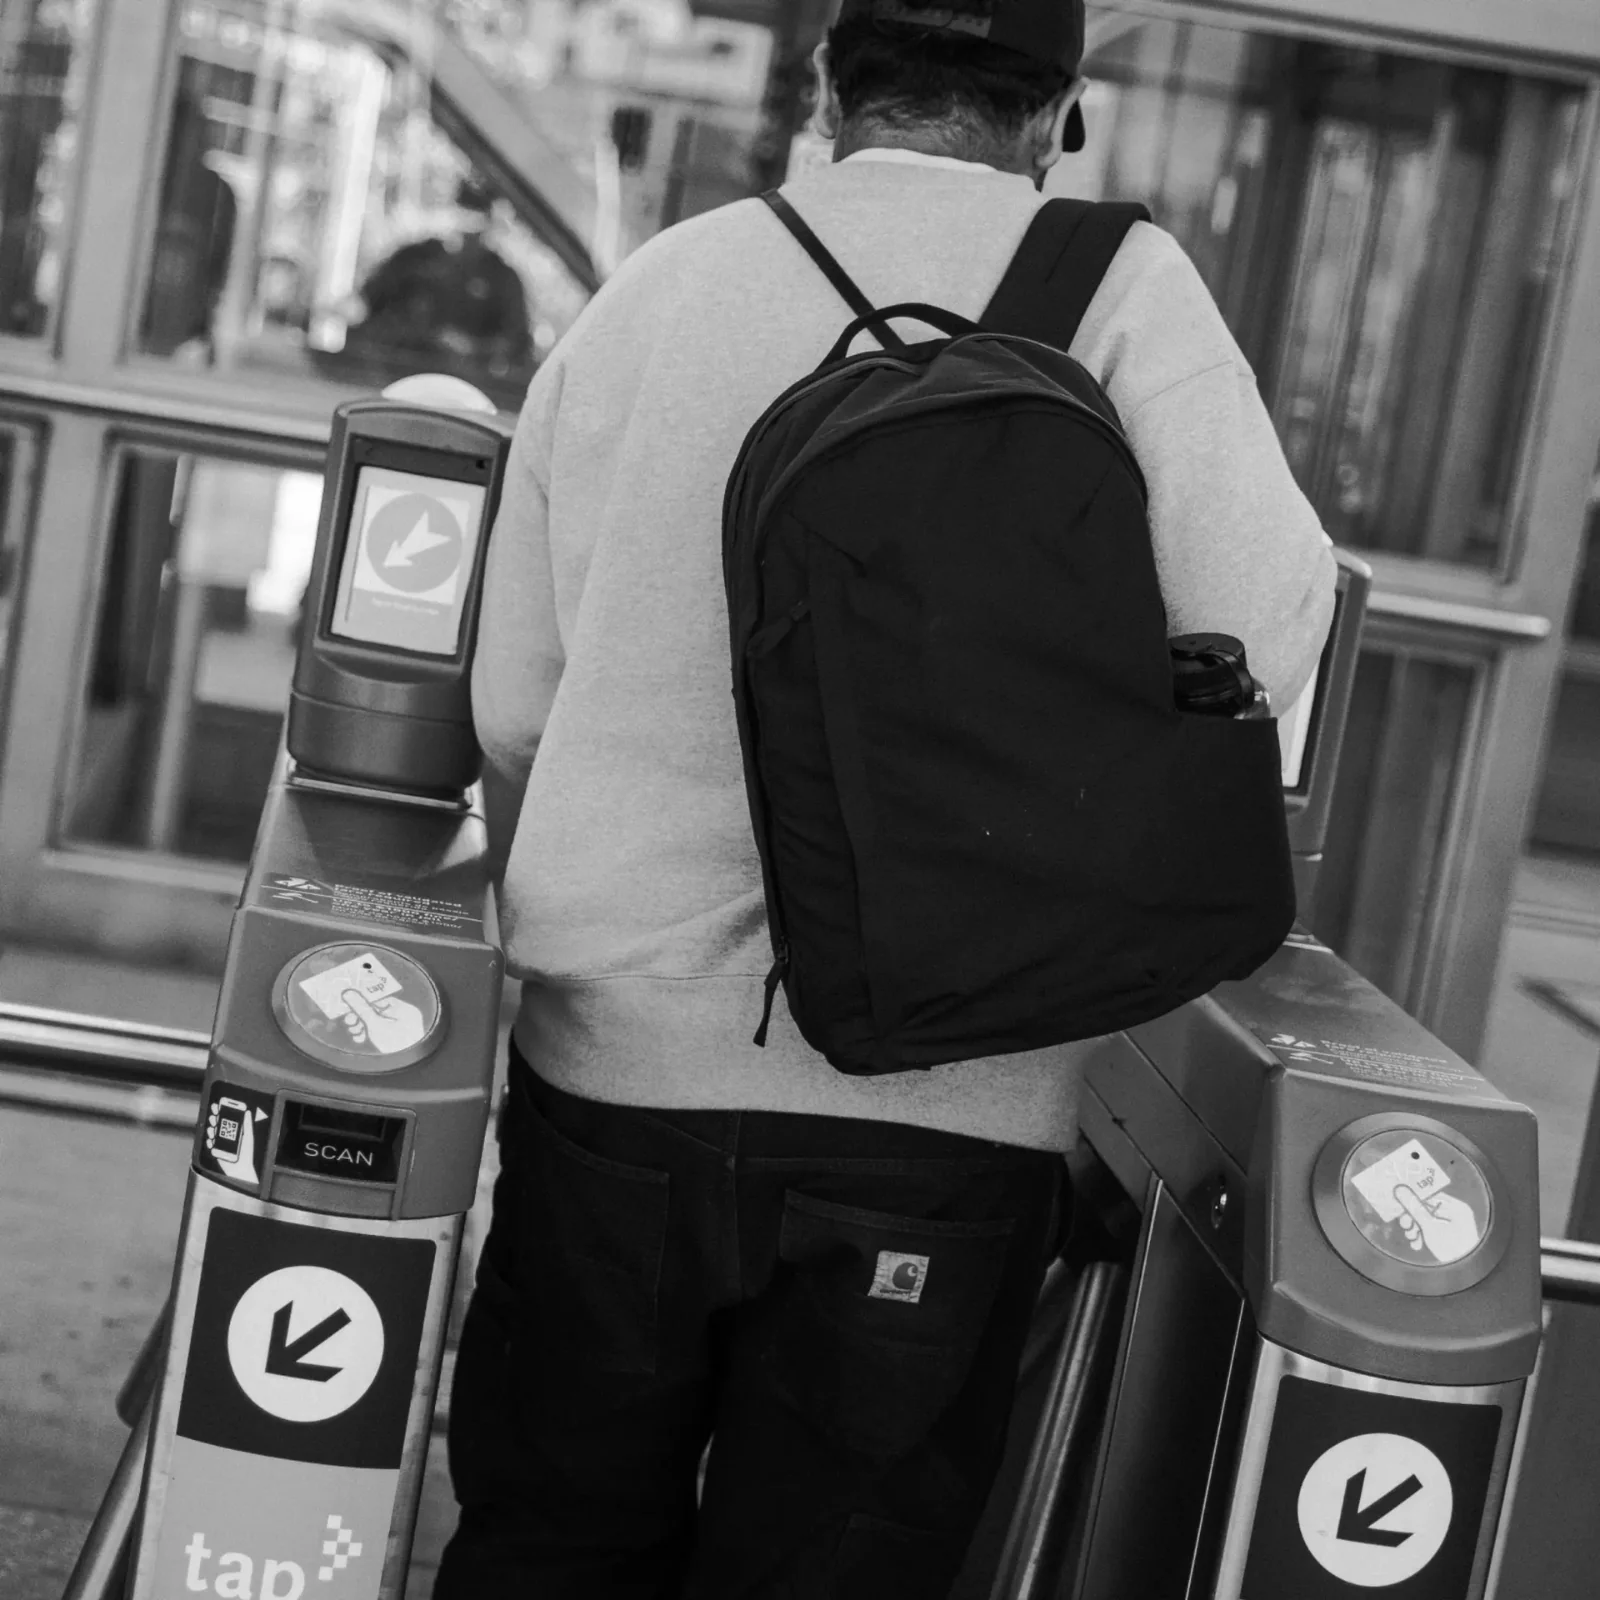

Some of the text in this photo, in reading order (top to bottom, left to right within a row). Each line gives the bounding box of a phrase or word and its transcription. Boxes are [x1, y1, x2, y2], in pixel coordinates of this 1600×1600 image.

[304, 1142, 373, 1166] SCAN
[1416, 1176, 1434, 1189] tap
[184, 1532, 305, 1600] tap
